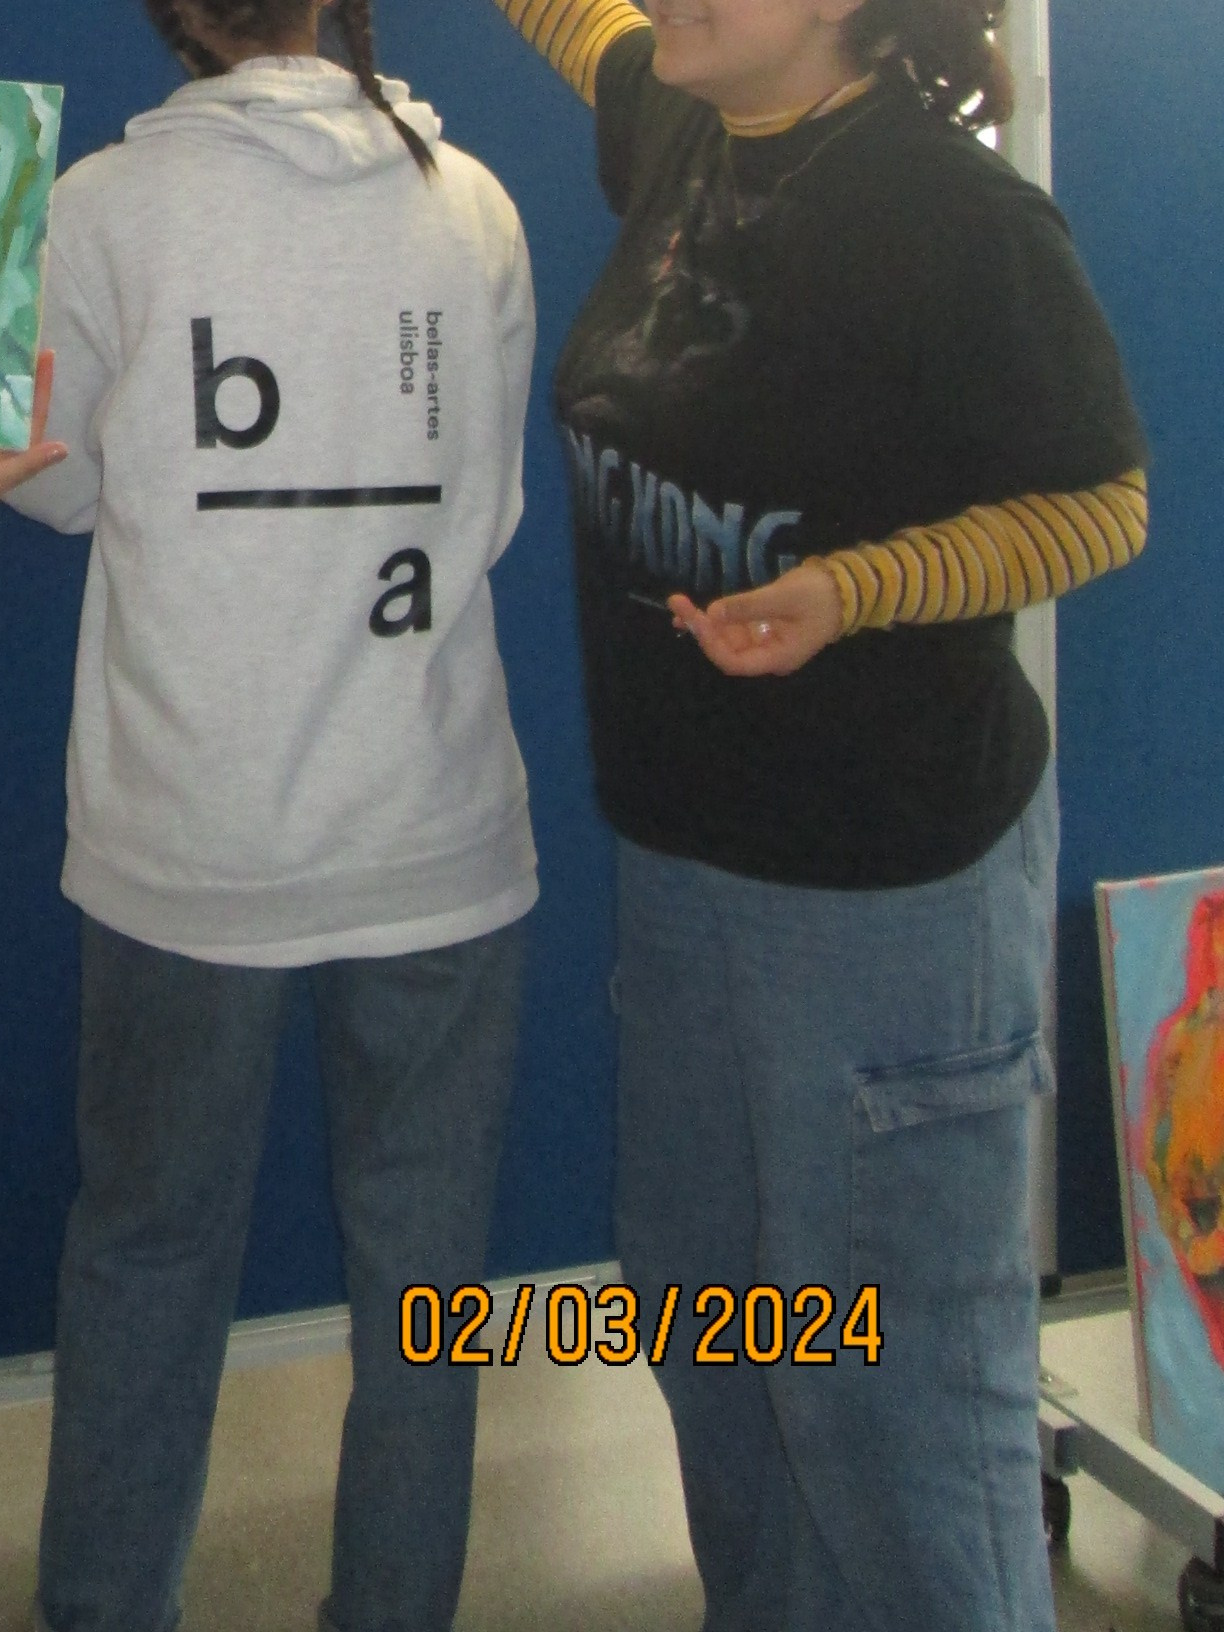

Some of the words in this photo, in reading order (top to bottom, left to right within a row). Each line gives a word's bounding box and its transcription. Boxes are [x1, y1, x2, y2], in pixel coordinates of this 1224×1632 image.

[190, 317, 280, 450] b
[399, 310, 420, 396] ulisboa
[426, 310, 444, 441] belas-artes
[369, 547, 432, 638] a
